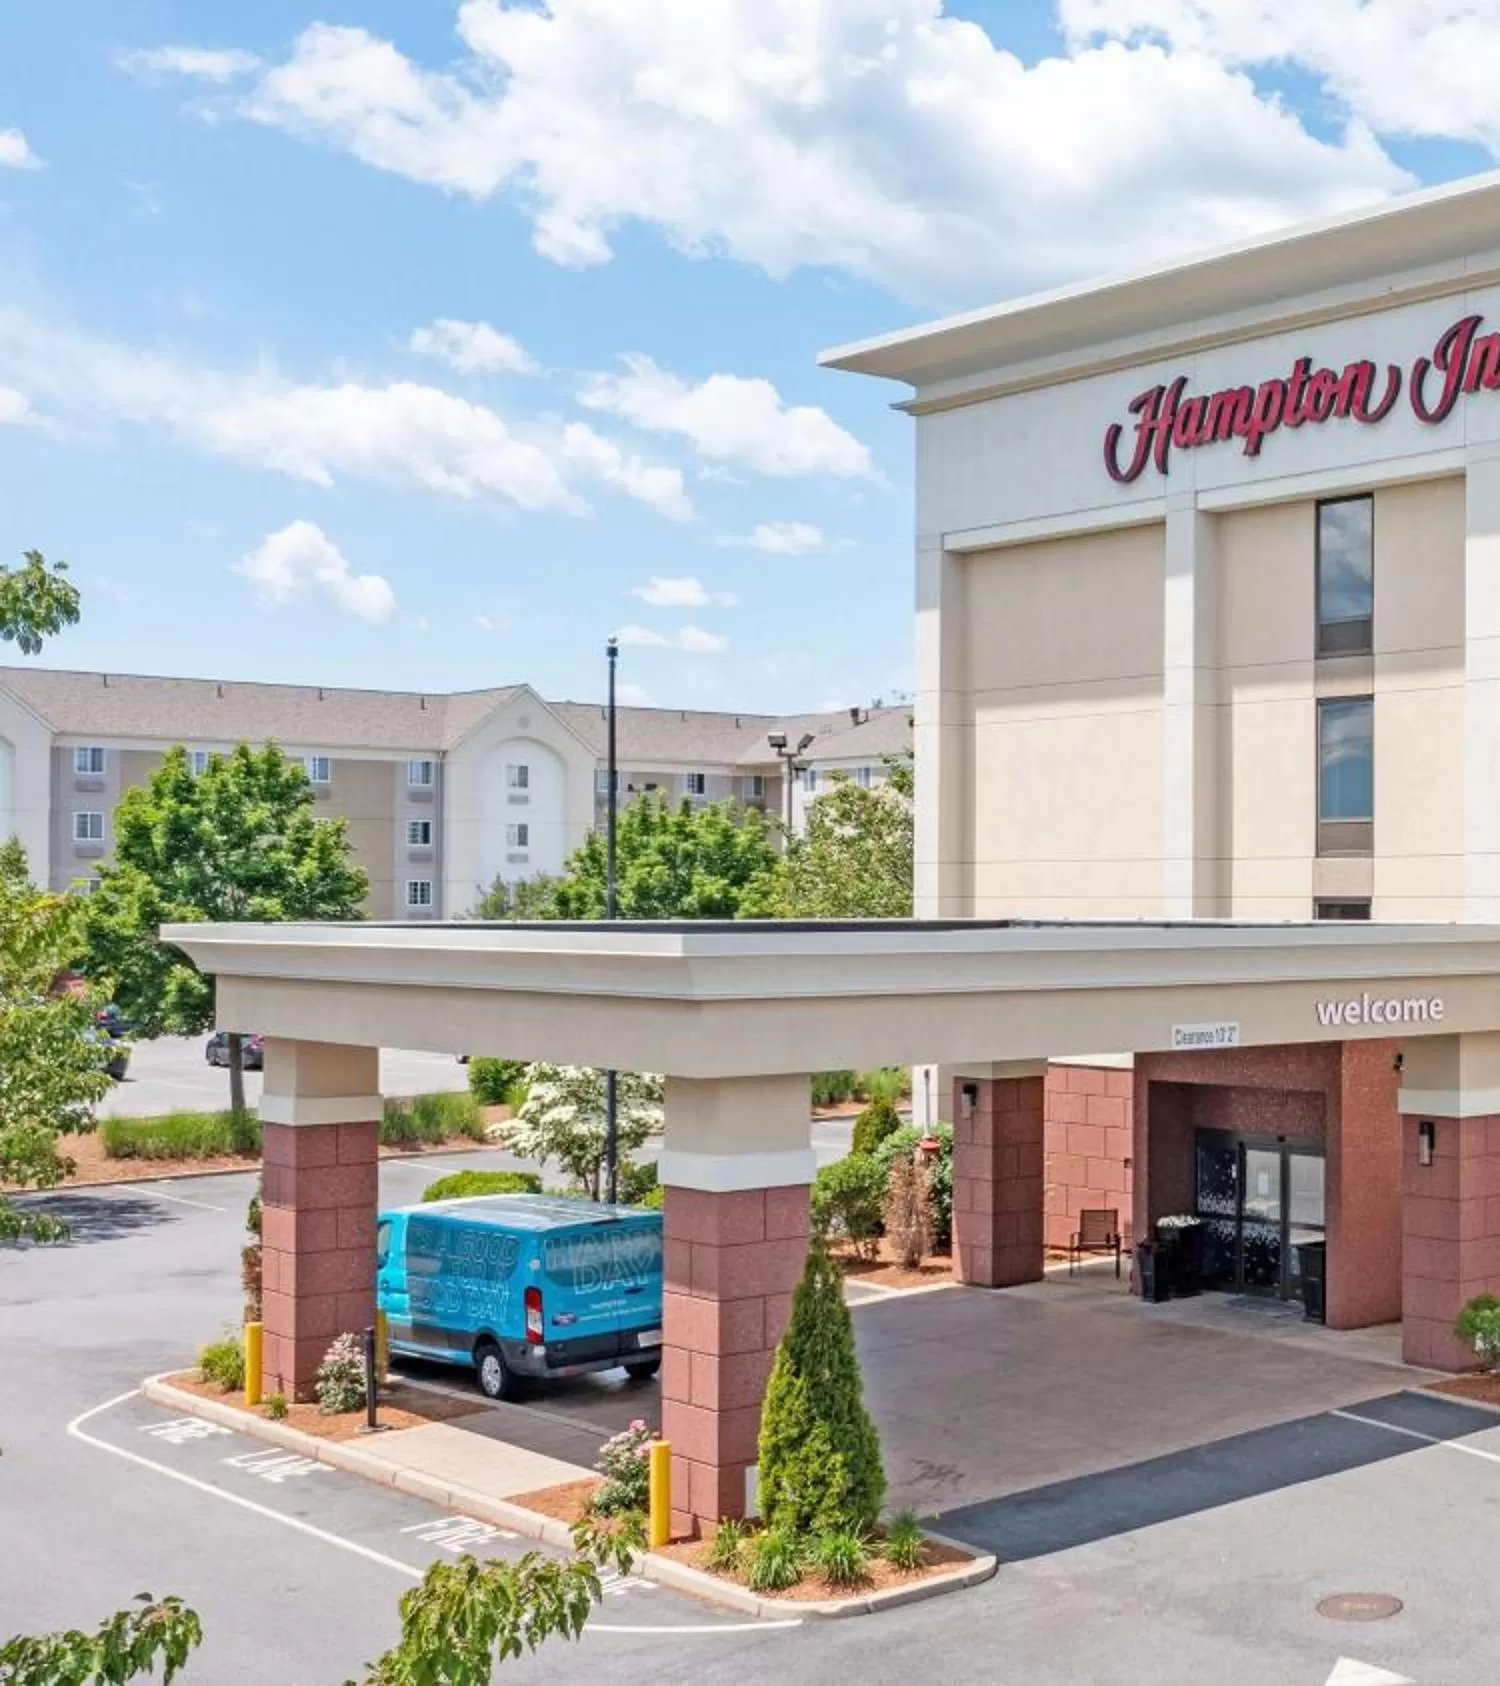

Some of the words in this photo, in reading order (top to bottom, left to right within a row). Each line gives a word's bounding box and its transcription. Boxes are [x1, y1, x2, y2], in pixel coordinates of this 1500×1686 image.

[1104, 357, 1402, 484] Hampton
[1316, 993, 1445, 1026] welcome
[1174, 1027, 1216, 1047] Clearance
[573, 1252, 656, 1295] DAY
